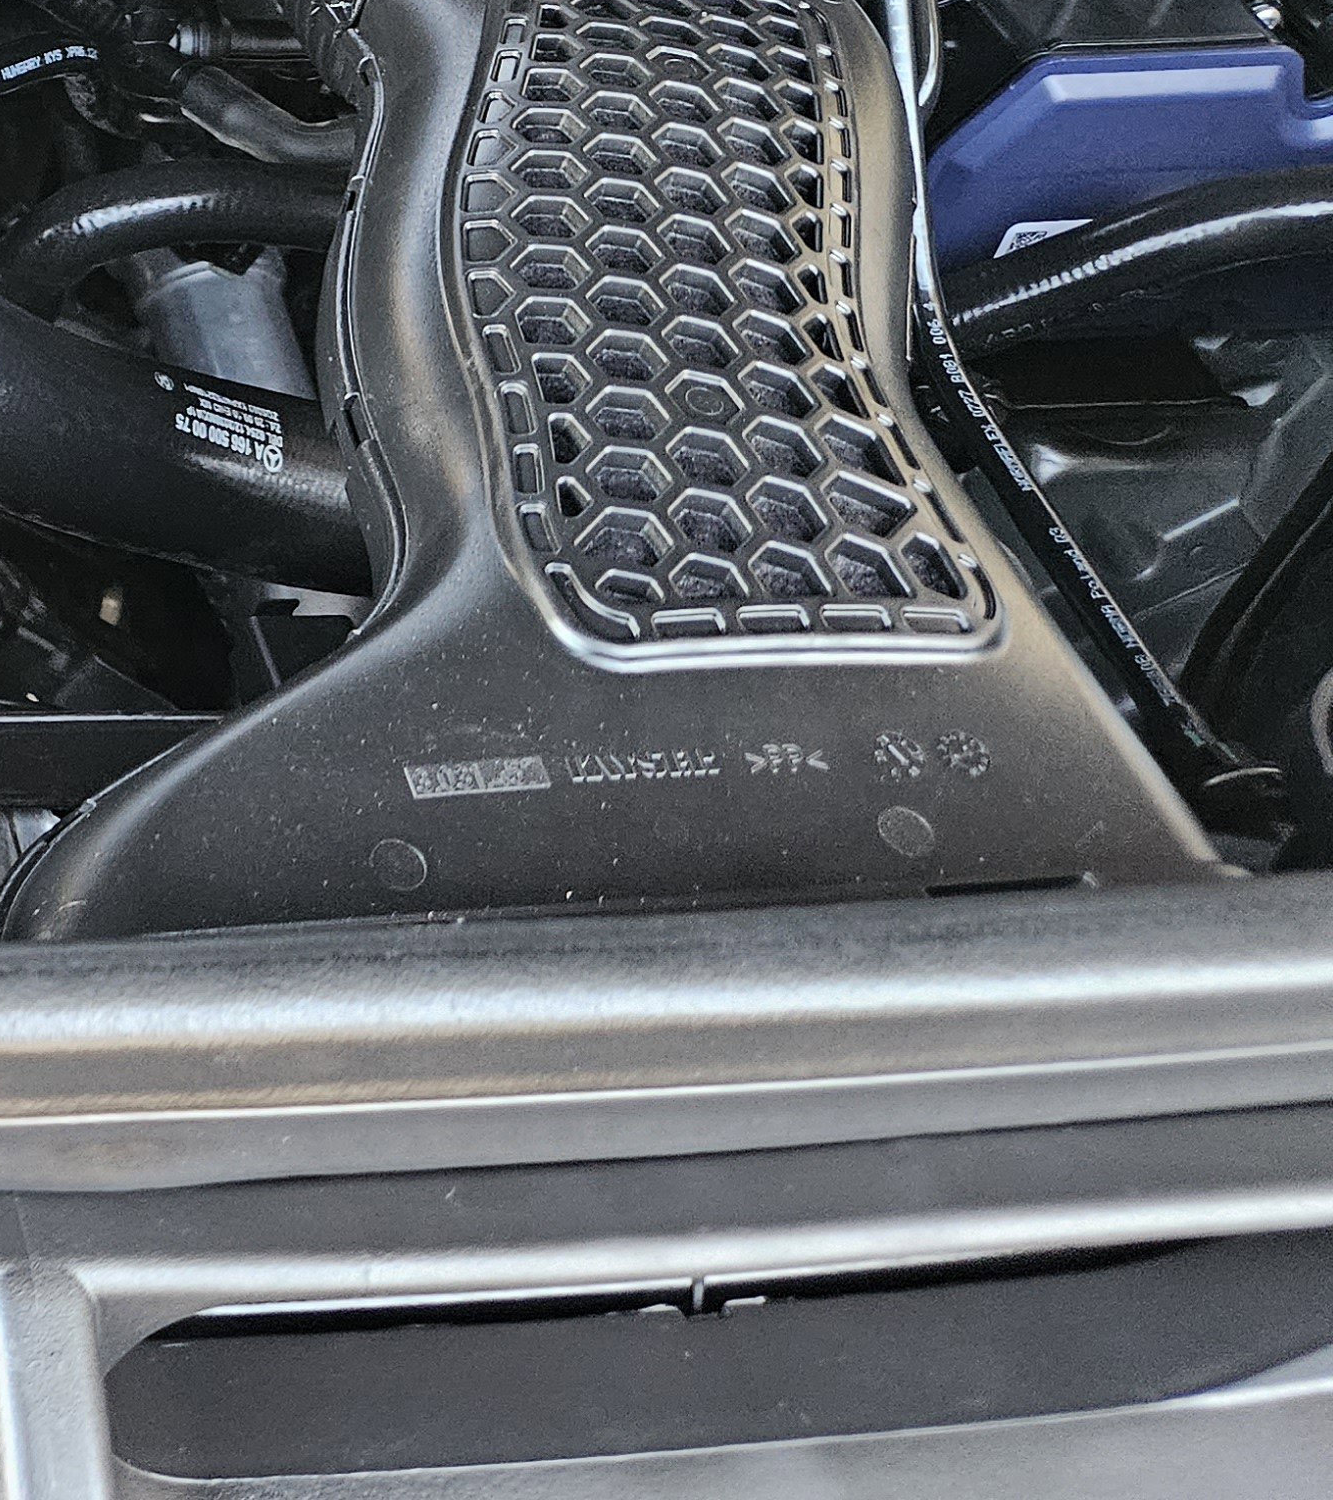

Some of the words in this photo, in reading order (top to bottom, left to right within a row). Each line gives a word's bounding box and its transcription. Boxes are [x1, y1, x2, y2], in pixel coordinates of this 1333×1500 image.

[175, 413, 192, 434] 75
[230, 434, 253, 456] 166
[254, 441, 265, 461] A
